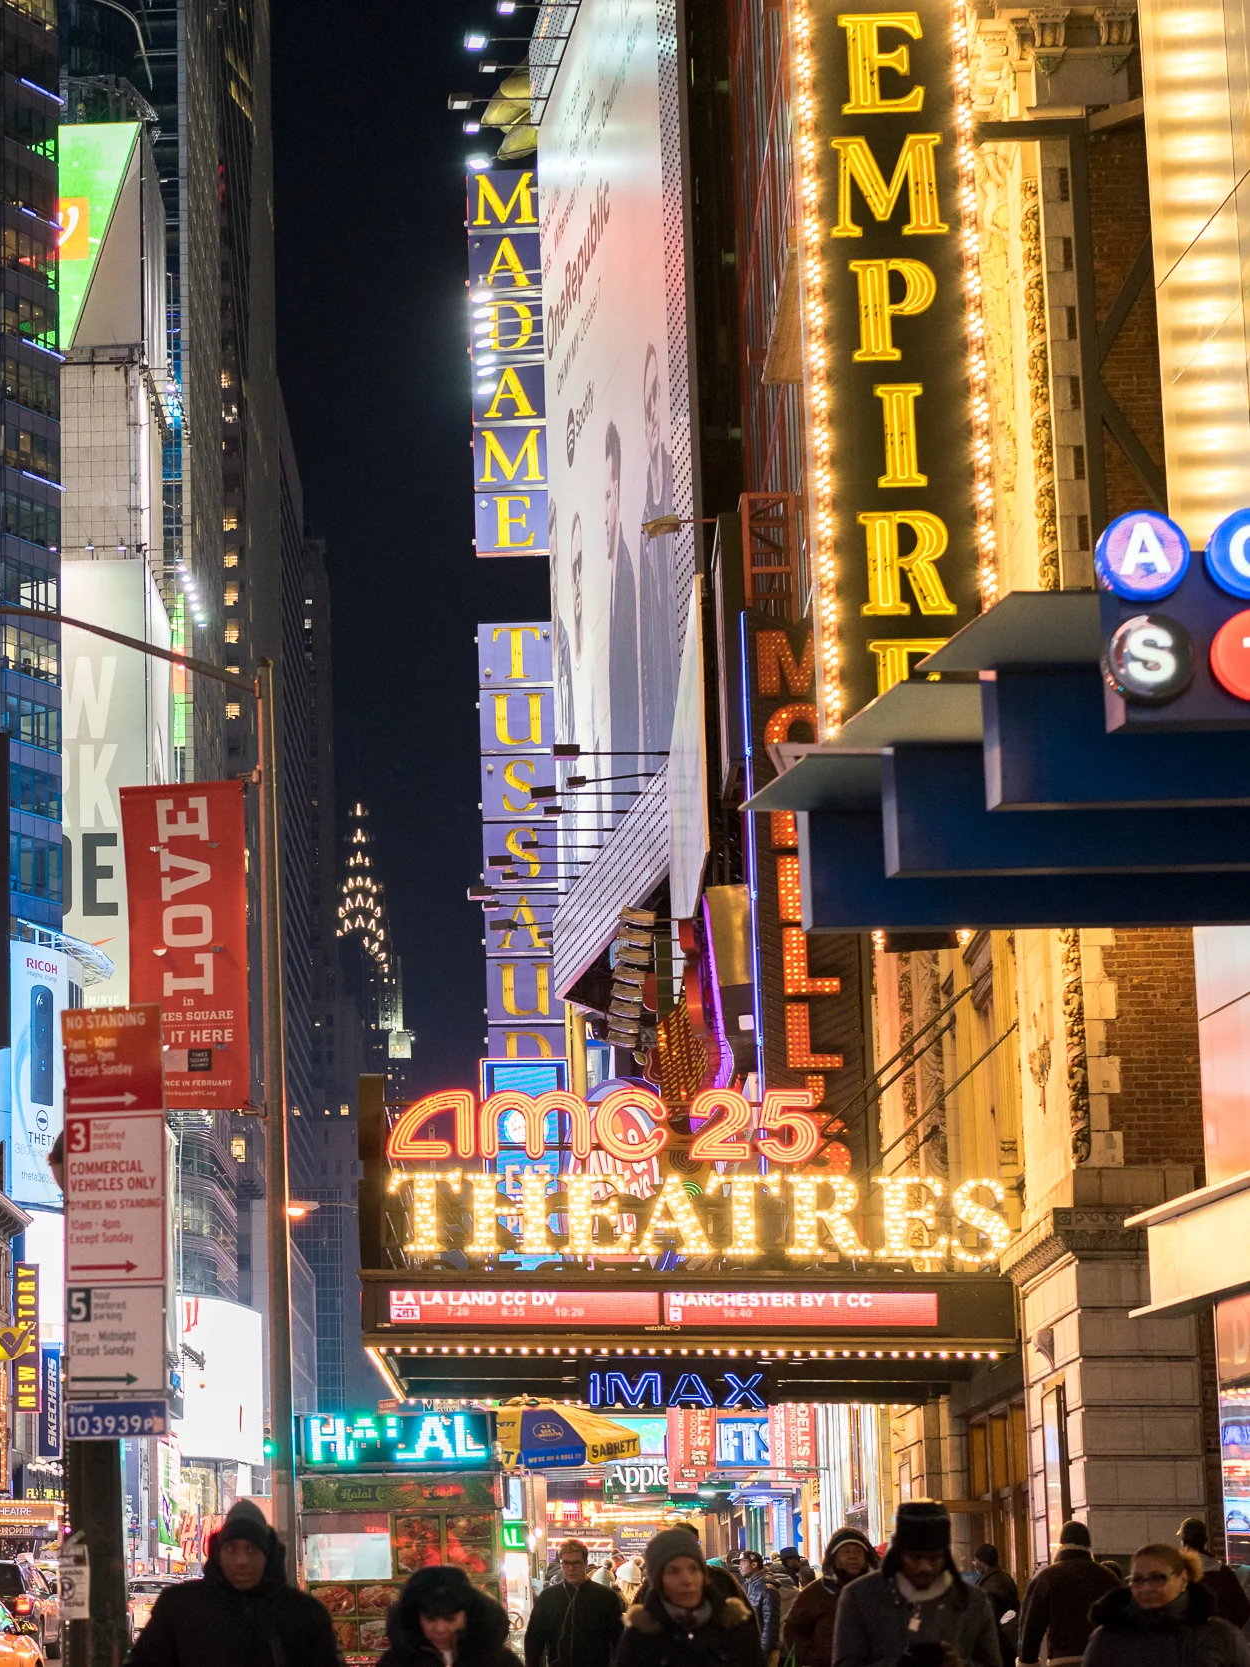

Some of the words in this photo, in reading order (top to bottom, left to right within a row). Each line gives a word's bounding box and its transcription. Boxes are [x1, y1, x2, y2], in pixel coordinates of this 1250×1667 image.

[546, 177, 610, 361] OneRepublic
[473, 172, 545, 548] MADAME
[575, 379, 595, 440] Spotify
[1119, 521, 1172, 576] A
[1127, 626, 1176, 683] S
[157, 796, 214, 997] LOVE
[26, 958, 58, 975] RICOH
[183, 996, 194, 1006] in
[66, 1016, 82, 1029] NO
[86, 1012, 146, 1029] STANDING
[186, 1010, 234, 1022] SQUARE
[170, 1030, 185, 1043] IT
[190, 1029, 234, 1042] HERE
[68, 1065, 99, 1078] Except
[100, 1063, 134, 1077] Sunday
[70, 1122, 86, 1151] 3
[387, 1088, 668, 1162] amc
[689, 1088, 820, 1164] 25
[70, 1160, 144, 1176] COMMERCIAL
[70, 1176, 125, 1193] VEHICLES
[128, 1175, 157, 1190] ONLY
[70, 1199, 103, 1211] OTHERS
[119, 1198, 162, 1210] STANDING
[387, 1167, 1011, 1263] THEATRES
[70, 1292, 87, 1322] 5
[391, 1292, 415, 1306] LA
[420, 1292, 443, 1306] LA
[447, 1292, 496, 1306] LAND
[500, 1292, 530, 1306] CC
[532, 1292, 557, 1306] DV
[670, 1292, 796, 1308] MANCHESTER
[801, 1294, 826, 1308] BY
[830, 1294, 842, 1307] T
[846, 1294, 873, 1308] CC
[98, 1330, 137, 1342] Midnight
[644, 1324, 672, 1332] watchfire
[18, 1366, 36, 1408] NEW
[589, 1372, 765, 1408] IMAX
[48, 1357, 57, 1448] SKECHERS
[68, 1414, 142, 1436] 103939
[592, 1438, 638, 1459] SABRETT
[340, 1486, 372, 1501] Halal
